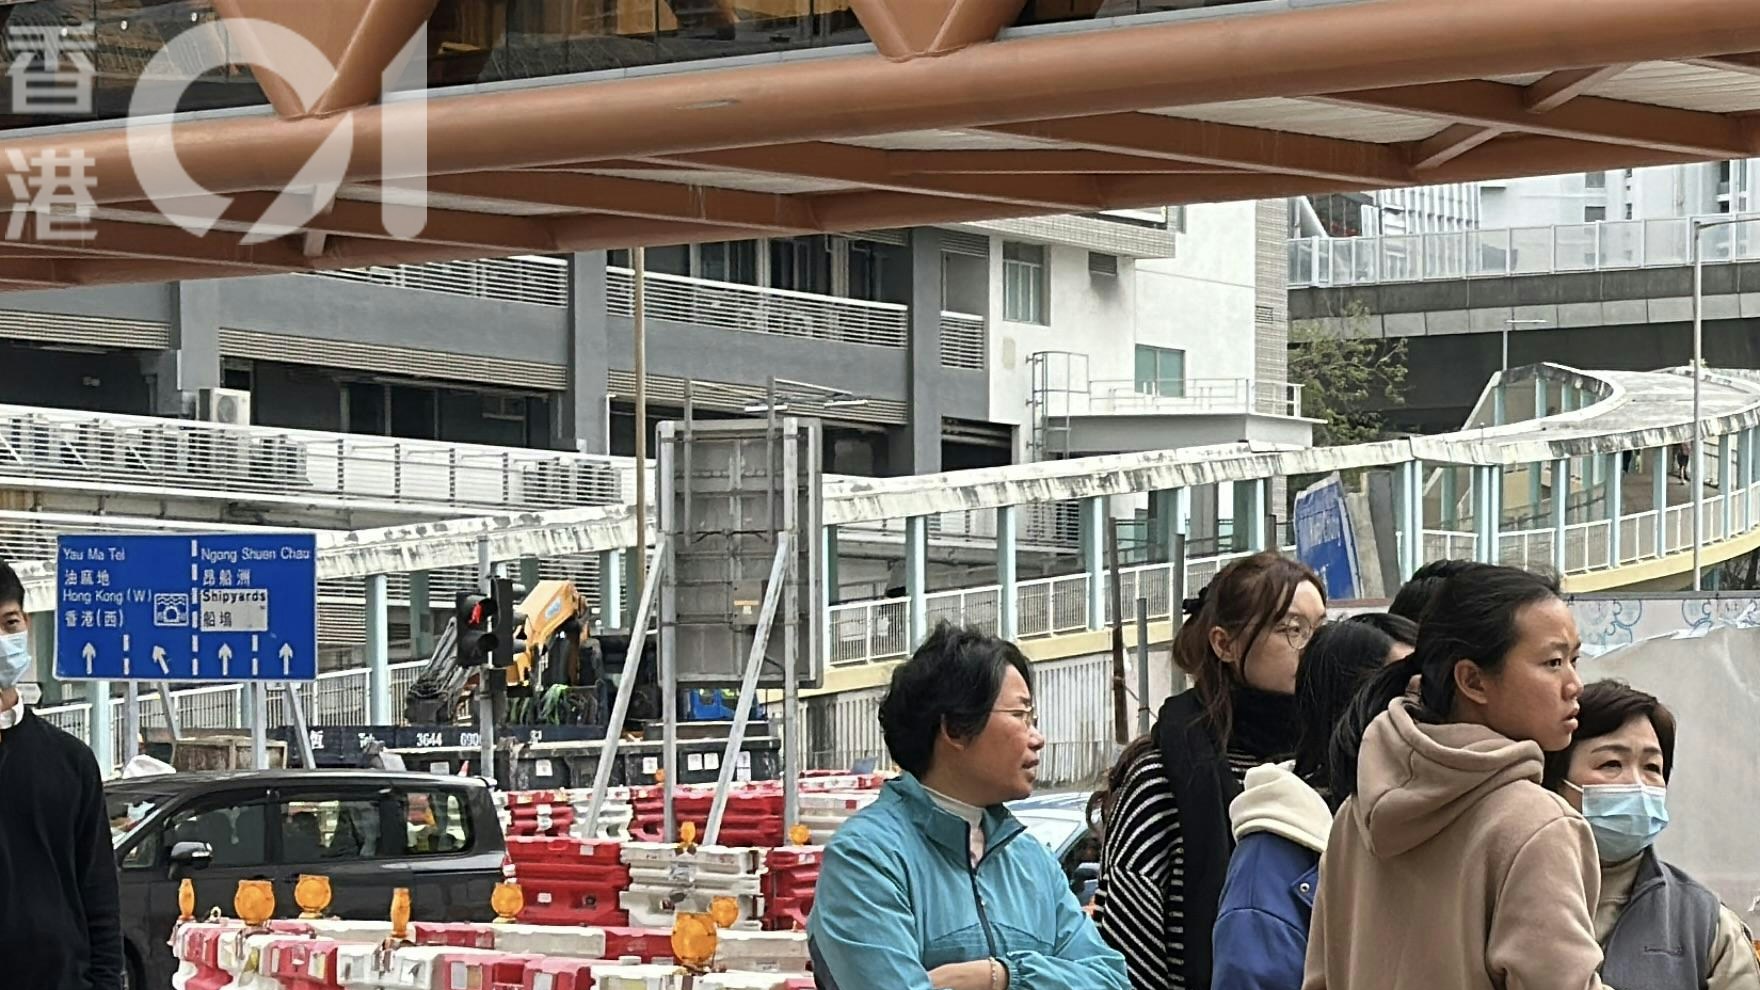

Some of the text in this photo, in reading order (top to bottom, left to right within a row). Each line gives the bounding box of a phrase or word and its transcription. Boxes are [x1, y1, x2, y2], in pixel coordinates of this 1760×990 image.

[63, 547, 84, 560] Yau
[88, 547, 105, 560] Ma
[201, 546, 310, 563] Ngong Shuen Chau
[64, 569, 111, 586] 油麻地
[202, 568, 251, 587] 昂船洲
[63, 588, 92, 605] Hong
[95, 589, 124, 606] Kong
[202, 589, 266, 604] Shipyards
[203, 611, 232, 628] 船塢
[416, 732, 442, 747] 3644
